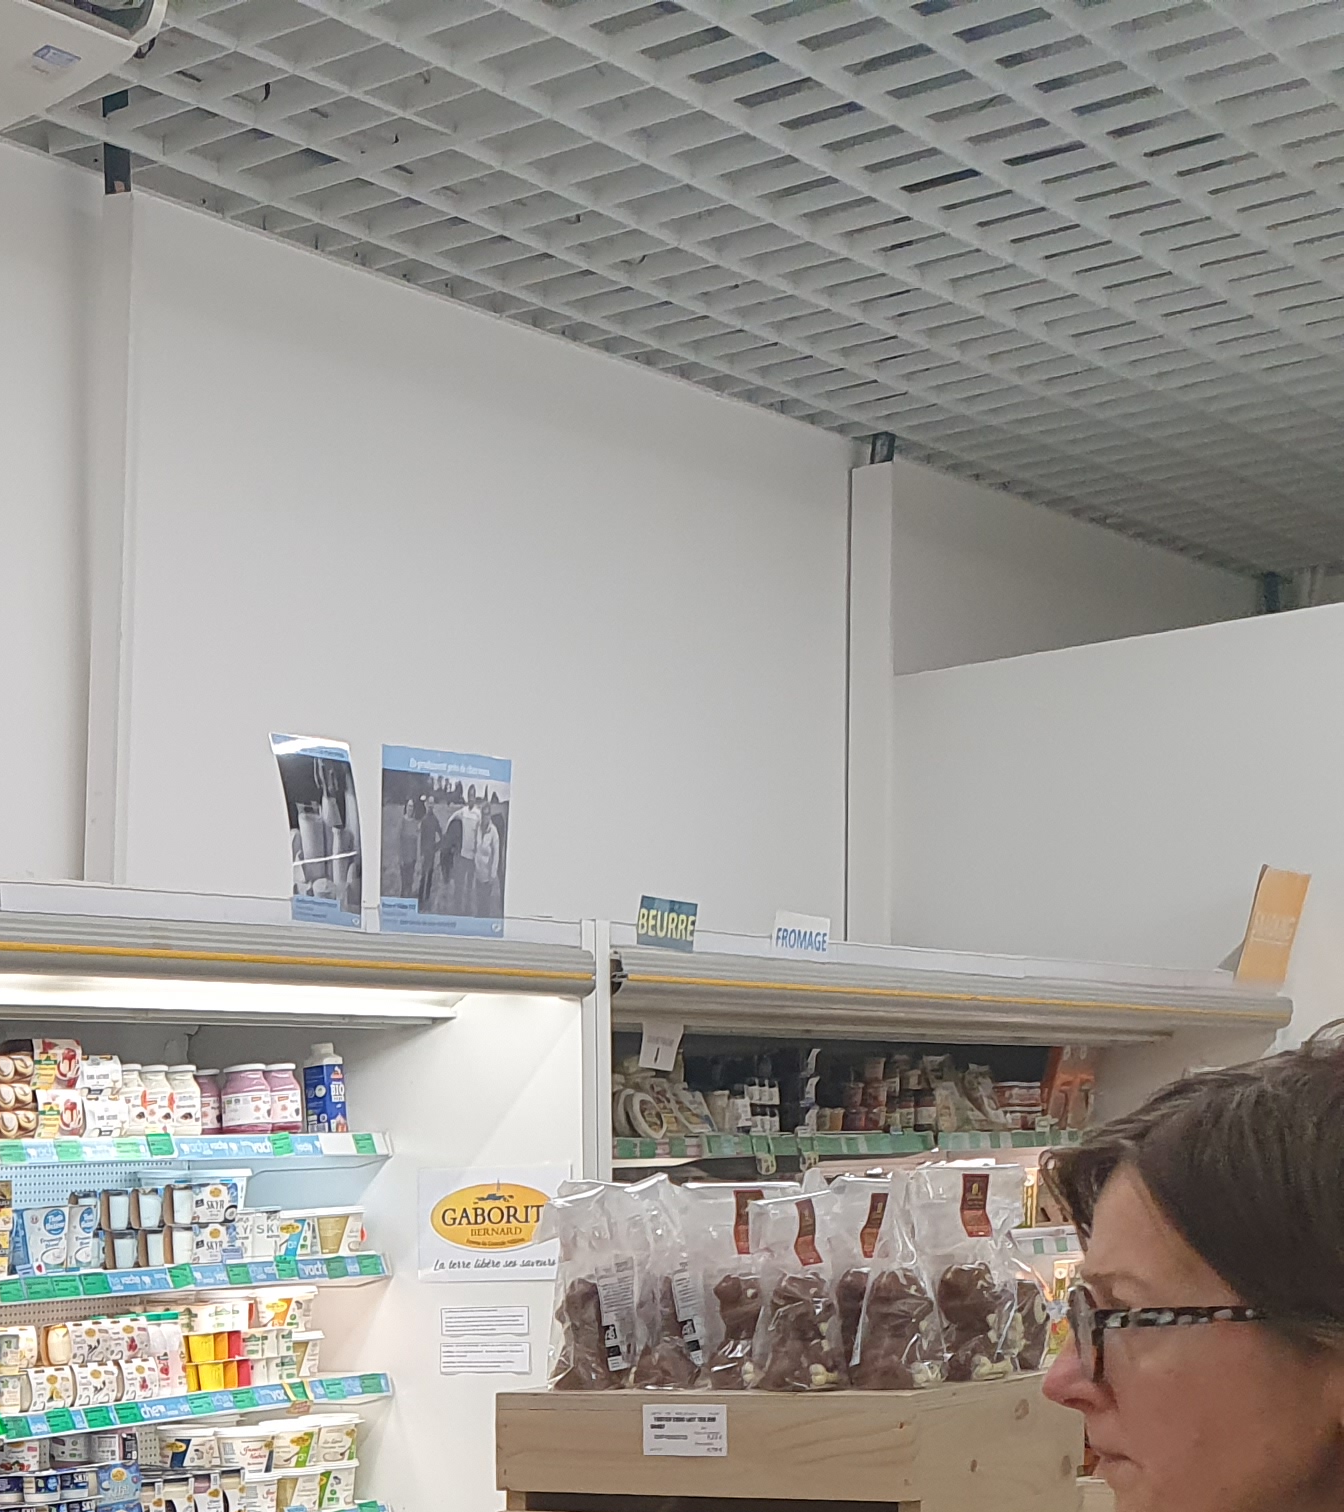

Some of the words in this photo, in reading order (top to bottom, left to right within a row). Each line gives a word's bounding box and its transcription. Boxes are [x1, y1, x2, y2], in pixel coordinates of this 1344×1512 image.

[638, 907, 696, 941] BEURRE
[775, 927, 828, 952] FROMAGE
[441, 1204, 545, 1227] GABORIT
[470, 1226, 522, 1237] BERNARD
[434, 1258, 445, 1272] La
[448, 1259, 471, 1270] terre
[474, 1257, 500, 1269] libère
[503, 1259, 517, 1268] ses
